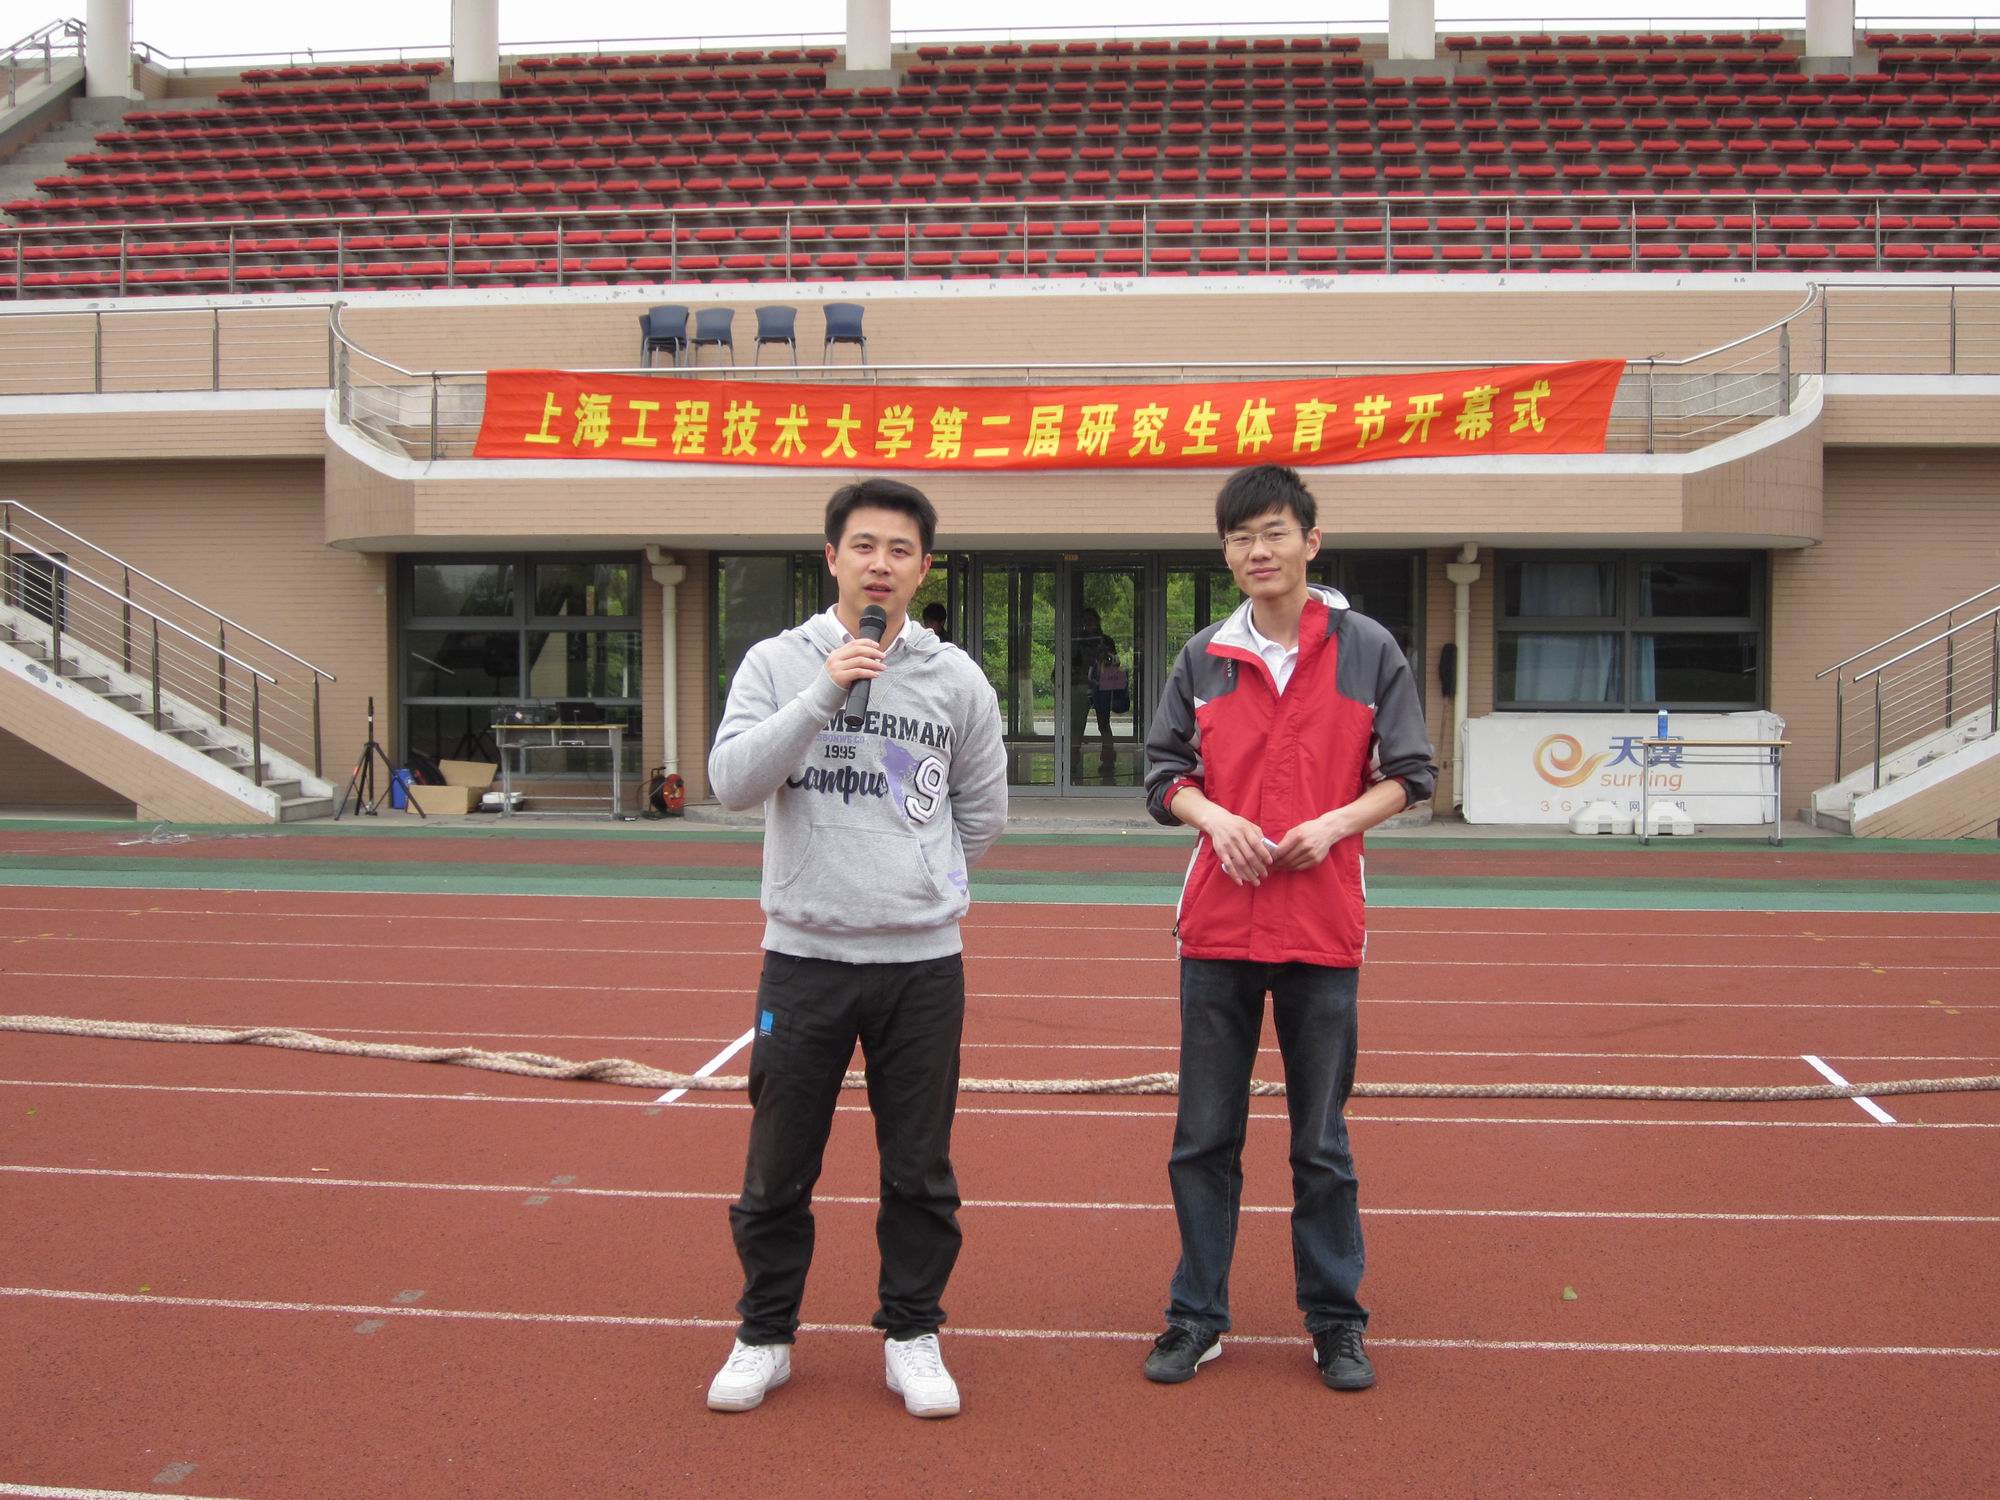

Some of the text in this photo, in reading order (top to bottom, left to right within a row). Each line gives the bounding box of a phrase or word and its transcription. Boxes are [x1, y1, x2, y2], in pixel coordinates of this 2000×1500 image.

[524, 377, 1552, 458] 上海工程技术大学第二届研究生体育节开幕式
[824, 745, 857, 760] 1995
[905, 755, 945, 825] 9
